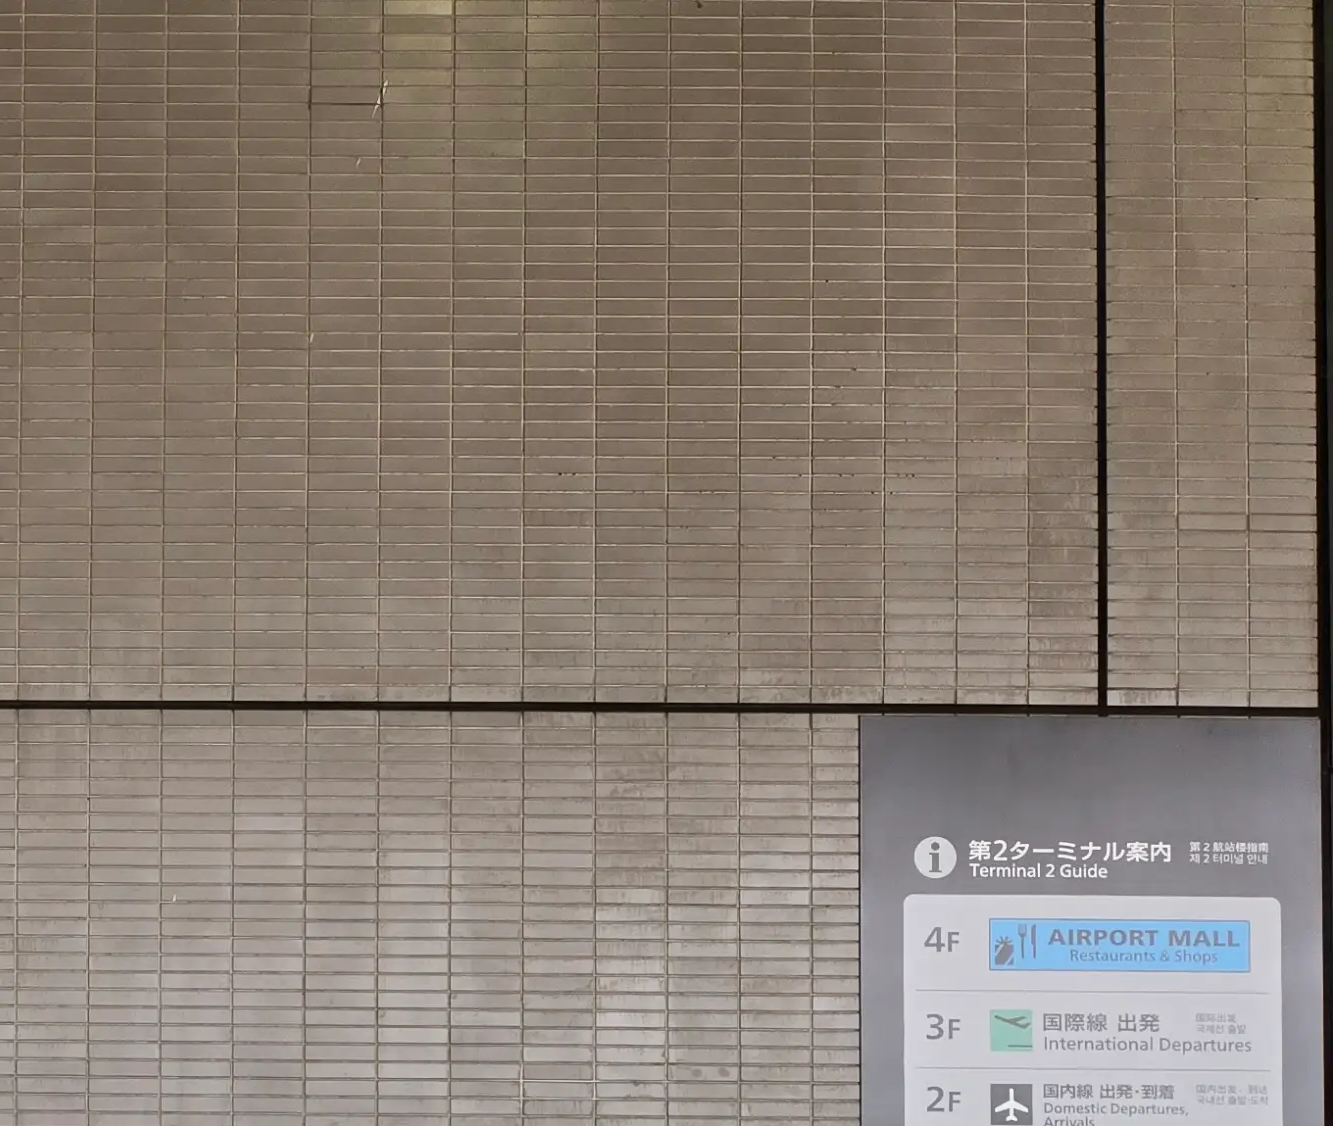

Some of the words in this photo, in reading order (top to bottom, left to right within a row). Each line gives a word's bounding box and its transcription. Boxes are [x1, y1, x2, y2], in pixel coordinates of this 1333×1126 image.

[969, 840, 1171, 862] 第2ターミナル案内
[969, 863, 1041, 878] Terminal
[1046, 864, 1055, 877] 2
[1060, 864, 1108, 878] Guide
[924, 927, 959, 952] 4F
[1048, 929, 1158, 946] AIRPORT
[1169, 930, 1239, 947] MALL
[1070, 949, 1155, 961] Restaurants
[1160, 950, 1169, 962] &
[1175, 949, 1218, 964] Shops
[926, 1014, 960, 1039] 3F
[1043, 1013, 1107, 1032] 国際線
[1118, 1014, 1159, 1032] 出発
[1045, 1036, 1153, 1051] International
[1160, 1038, 1251, 1055] Departures
[927, 1087, 961, 1112] 2F
[1044, 1084, 1093, 1099] 国内線
[1100, 1084, 1174, 1099] 出発・到着
[1044, 1103, 1106, 1114] Domestic
[1111, 1101, 1188, 1117] Departures,
